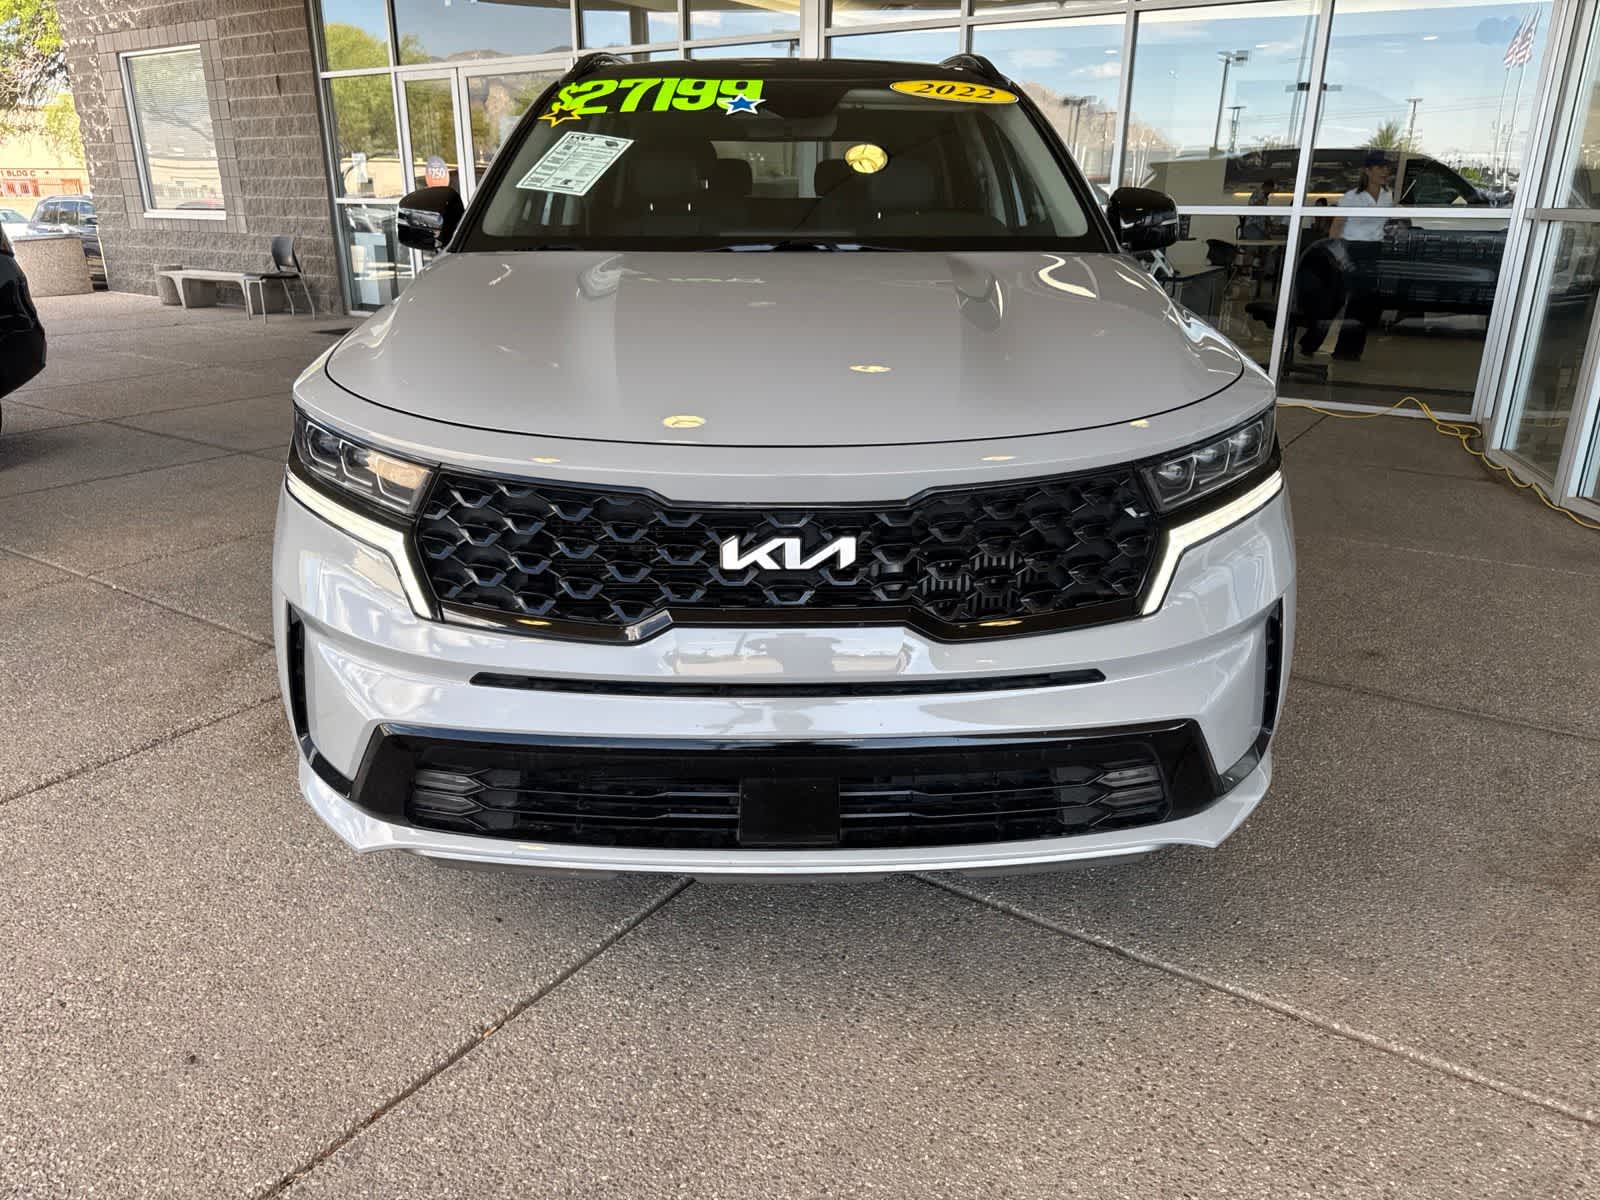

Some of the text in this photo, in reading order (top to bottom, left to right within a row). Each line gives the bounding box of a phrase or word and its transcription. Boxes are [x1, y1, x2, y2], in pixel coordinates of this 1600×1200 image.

[552, 78, 764, 115] $27199
[914, 83, 995, 99] 2022
[720, 536, 856, 570] KIA
